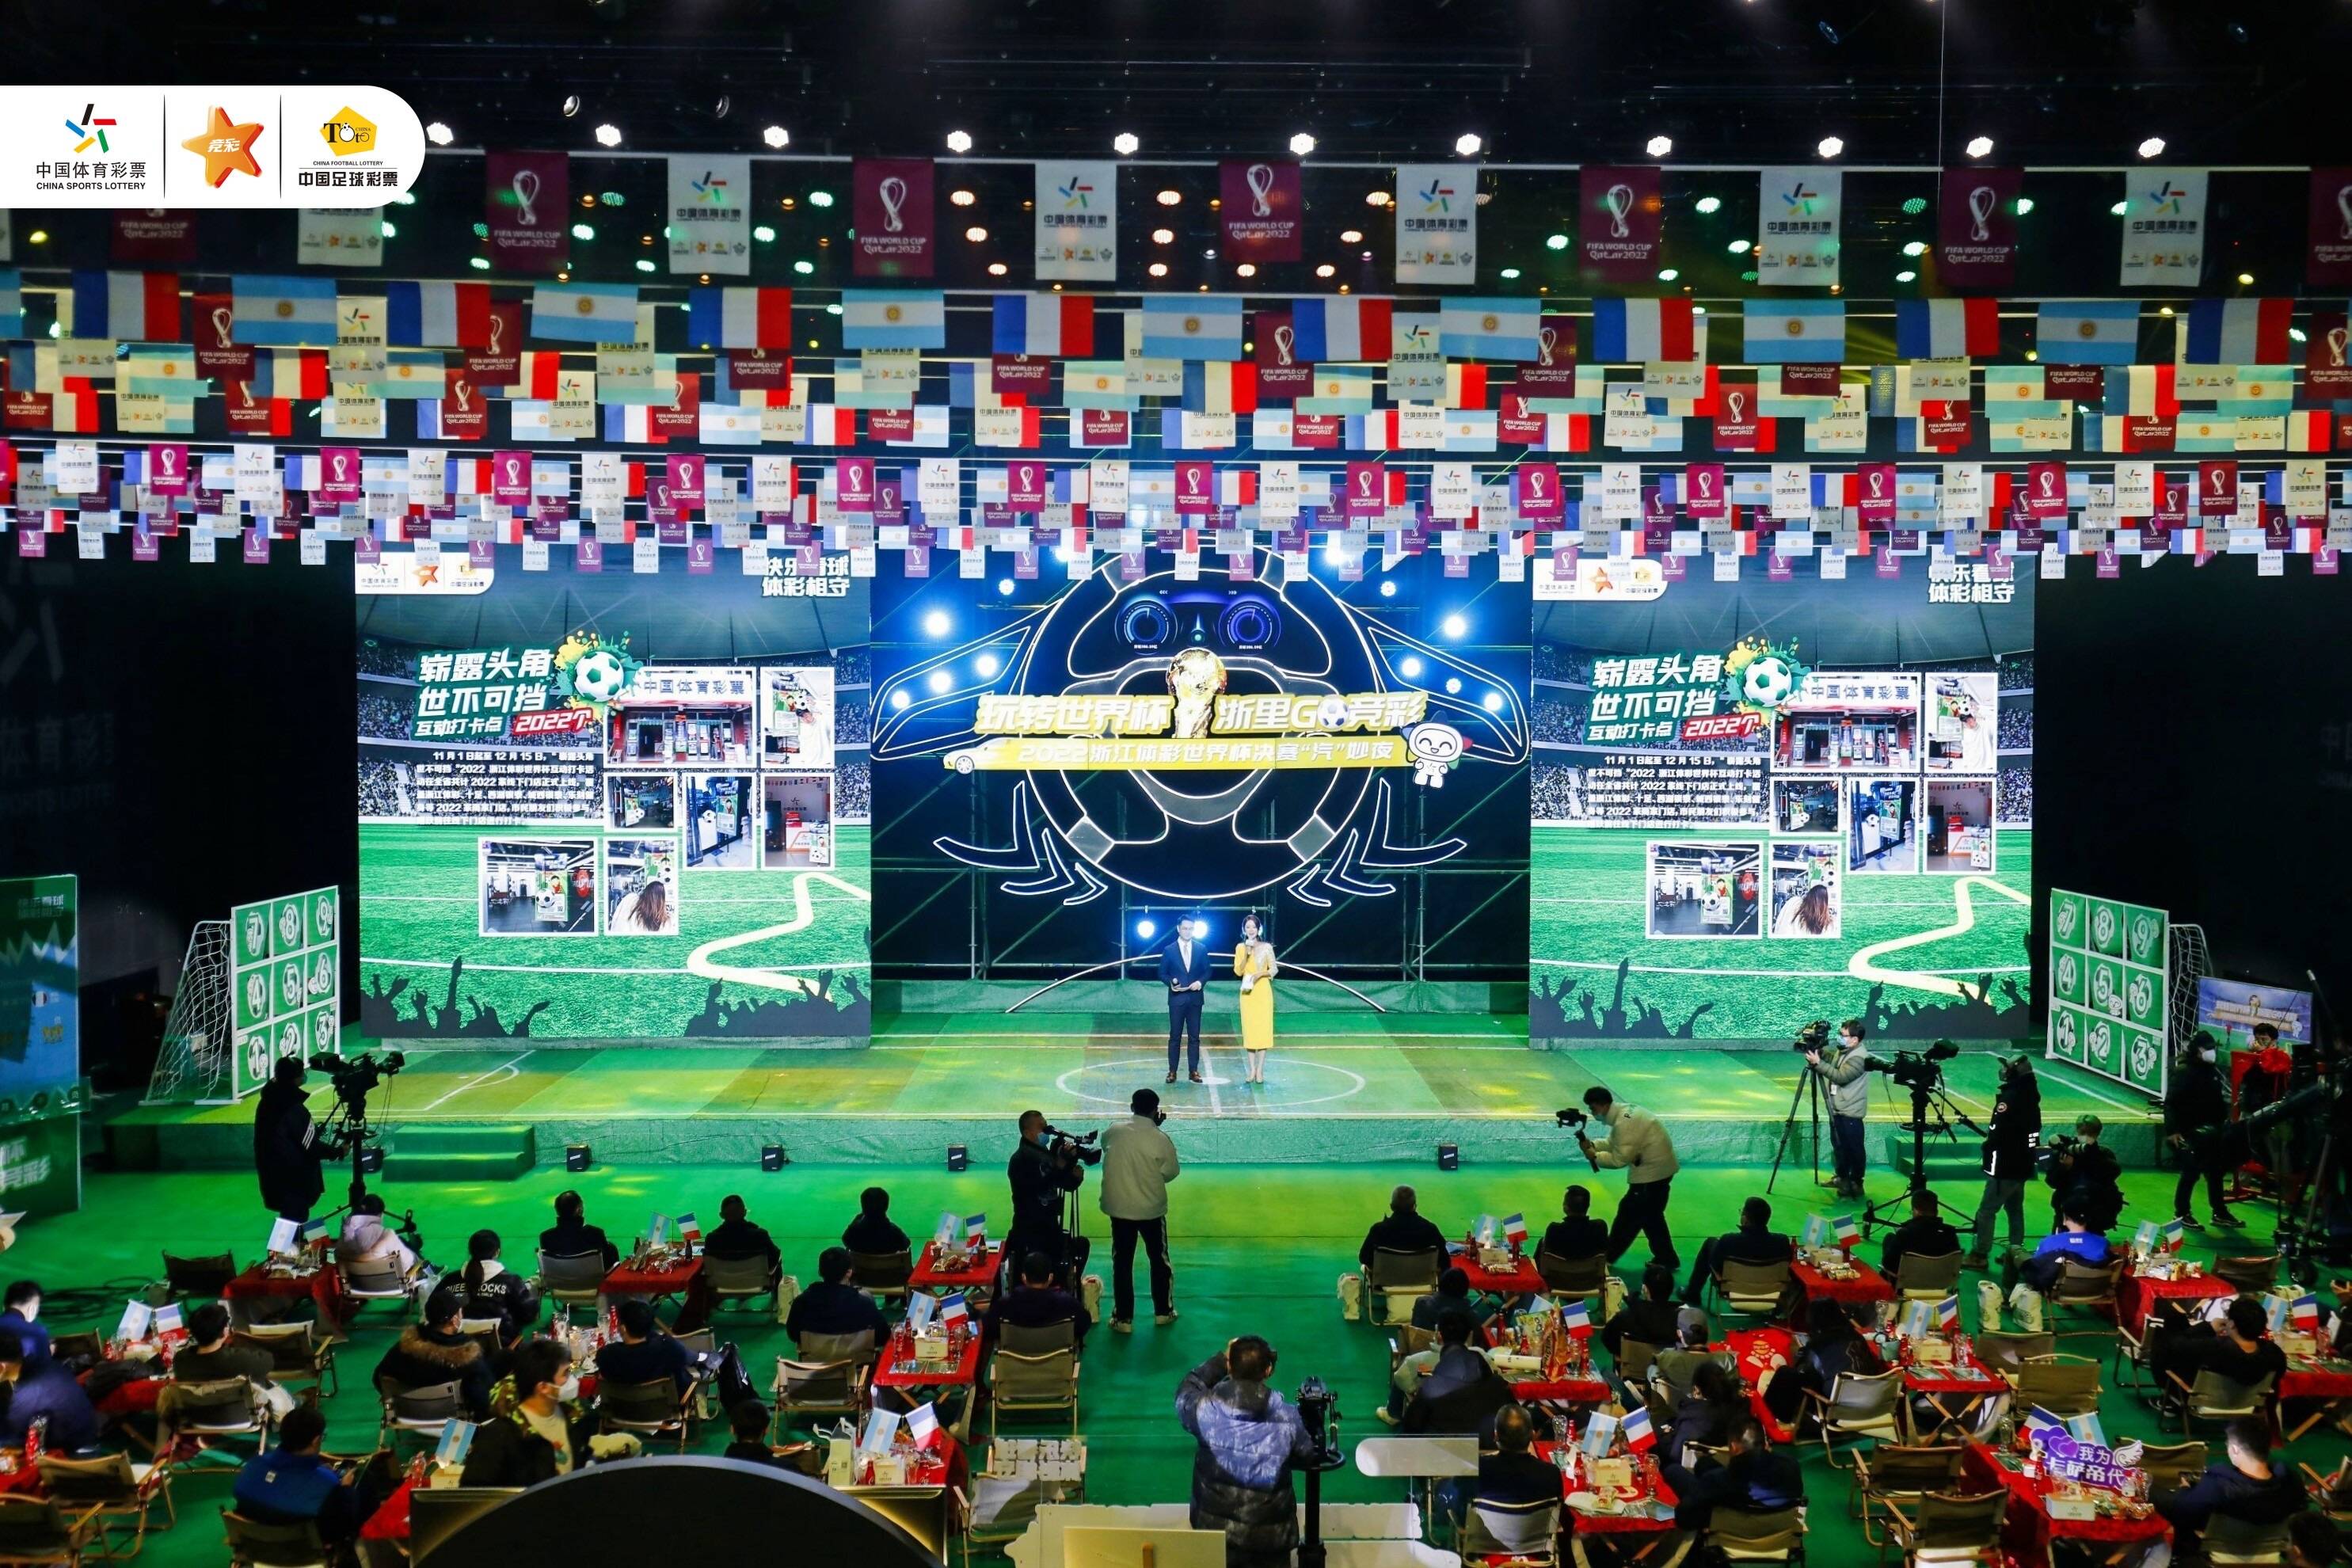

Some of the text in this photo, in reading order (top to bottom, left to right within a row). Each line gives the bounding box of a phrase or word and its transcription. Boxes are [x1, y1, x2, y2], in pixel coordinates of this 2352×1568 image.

[1044, 215, 1107, 226] 中国体育彩票
[1405, 219, 1468, 230] 中国体育彩票
[1768, 222, 1832, 233] 中国体育彩票
[762, 577, 850, 596] 体彩相守
[1928, 583, 2015, 603] 体彩相守
[418, 647, 554, 683] 崭露头角
[1593, 653, 1725, 688] 崭露头角
[644, 679, 744, 695] 中国体育彩票
[1811, 685, 1909, 700] 中国体育彩票
[418, 683, 547, 717] 世不可挡
[1590, 688, 1718, 721] 世不可挡
[415, 710, 592, 736] 互动打卡点 2022个
[980, 697, 1171, 730] 玩转世界杯
[1587, 714, 1760, 741] 互动打卡点 2022个
[445, 1283, 507, 1294] QUEE OCKS
[2080, 1446, 2110, 1465] 我为
